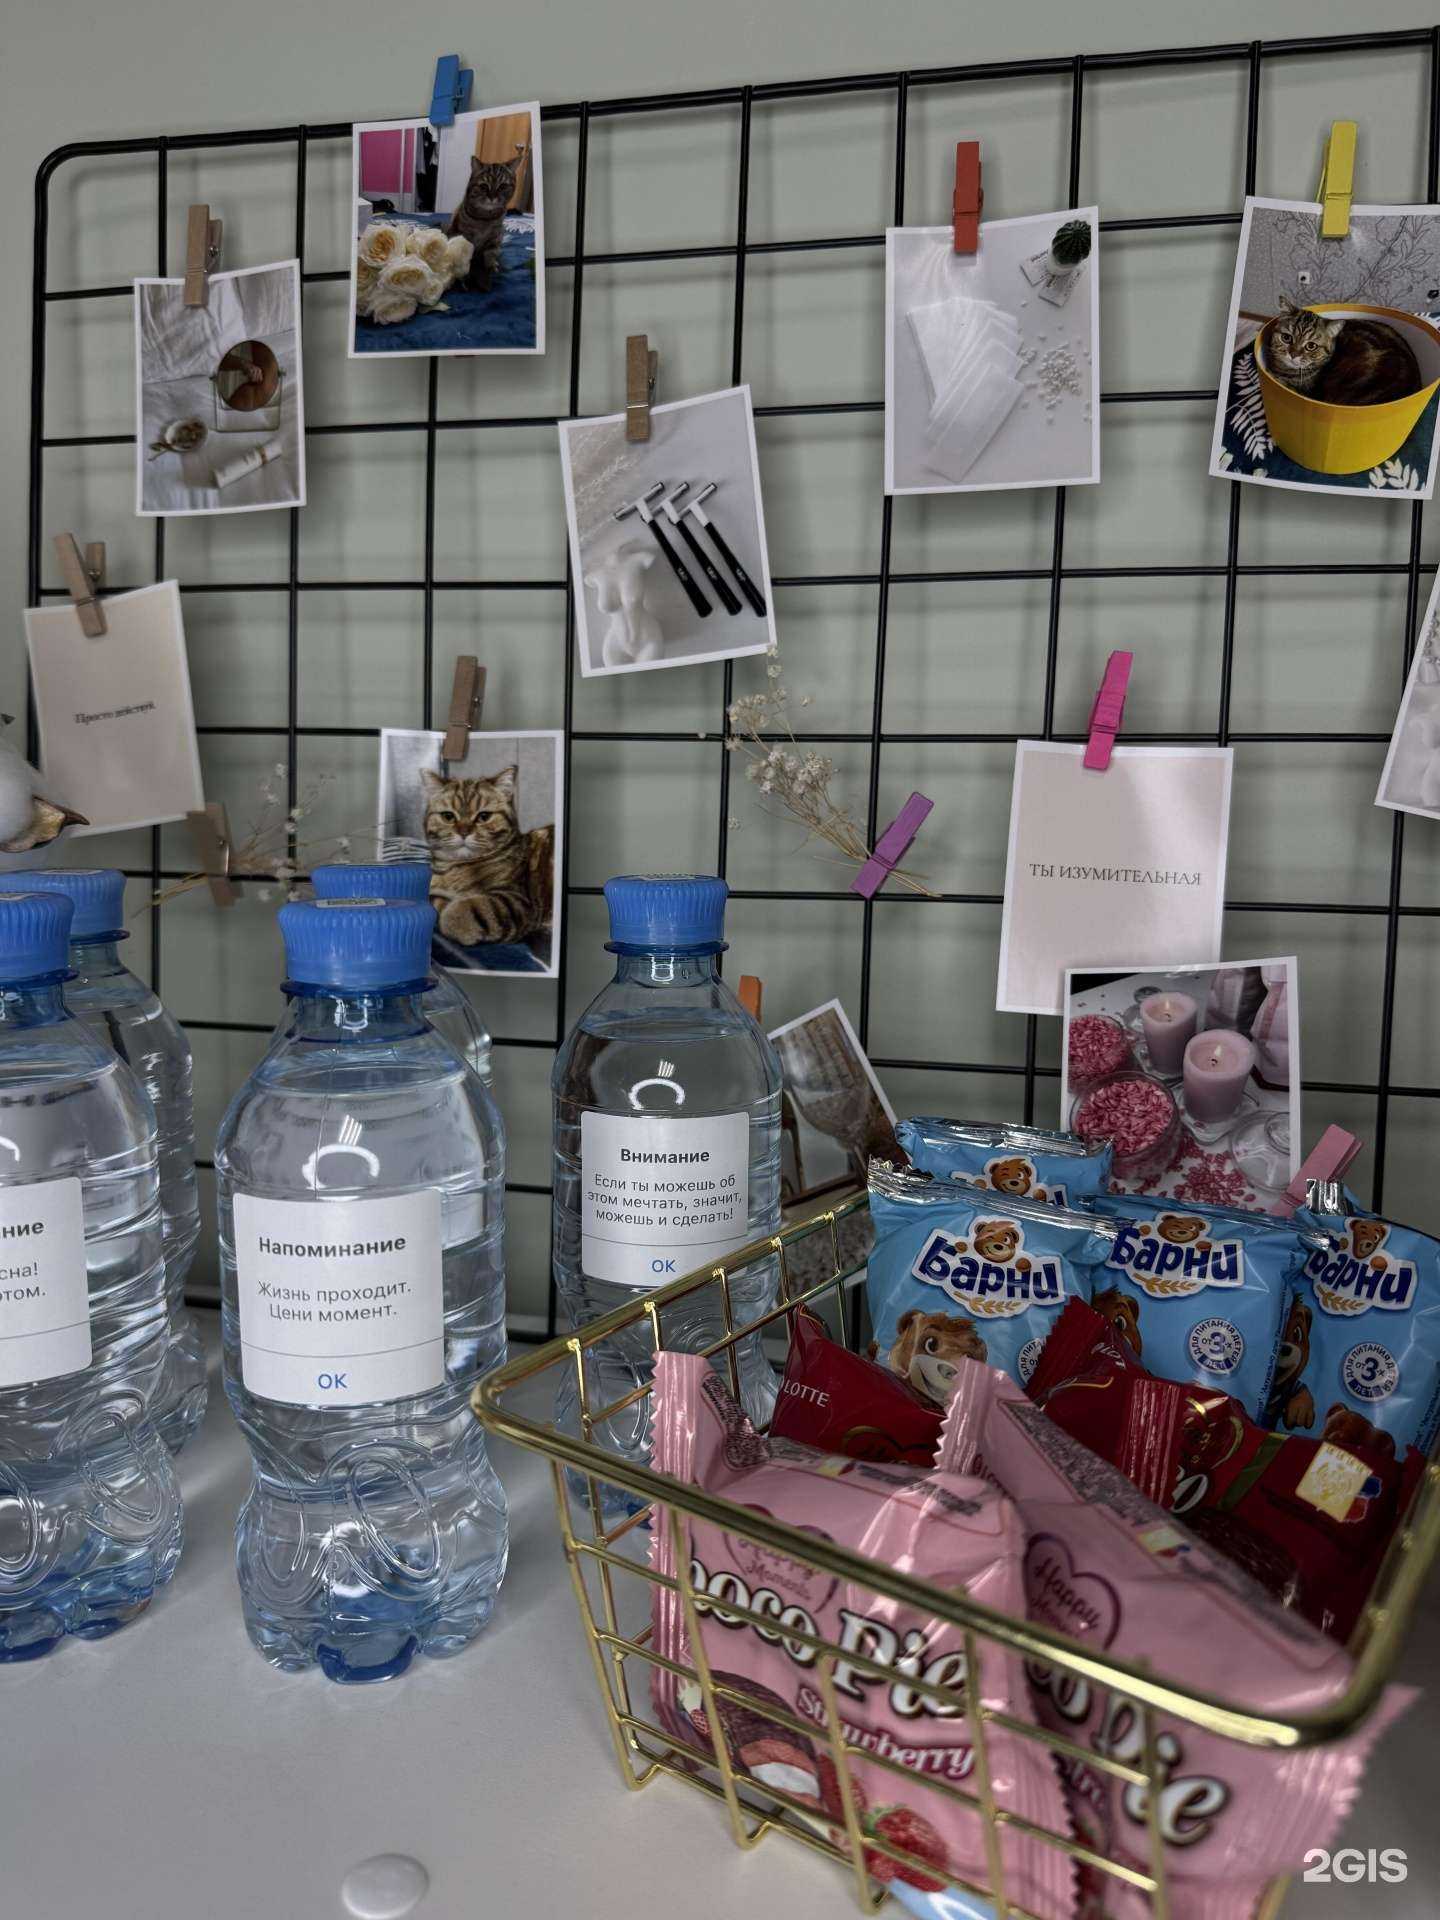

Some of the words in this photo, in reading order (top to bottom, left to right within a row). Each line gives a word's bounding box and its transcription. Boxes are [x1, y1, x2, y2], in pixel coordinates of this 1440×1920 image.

[1029, 863, 1054, 878] ТЫ
[1058, 865, 1202, 886] ИЗУМИТЕЛЬНАЯ
[620, 1148, 711, 1164] Внимание
[595, 1173, 626, 1190] Если
[631, 1181, 649, 1192] ты
[654, 1180, 716, 1193] можешь
[720, 1174, 736, 1188] об
[587, 1191, 618, 1206] этом
[622, 1198, 688, 1211] мечтать,
[693, 1191, 742, 1208] значит,
[596, 1209, 653, 1226] можешь
[658, 1216, 667, 1226] и
[672, 1208, 734, 1227] сделать!
[258, 1236, 407, 1257] Напоминание
[1110, 1225, 1238, 1280] Барни
[918, 1235, 1059, 1299] Барни
[258, 1279, 311, 1302] Жизнь
[316, 1281, 412, 1304] проходит.
[269, 1303, 312, 1322] Цени
[318, 1303, 398, 1322] момент.
[783, 1379, 831, 1408] LOTTE
[831, 1608, 969, 1719] Pie
